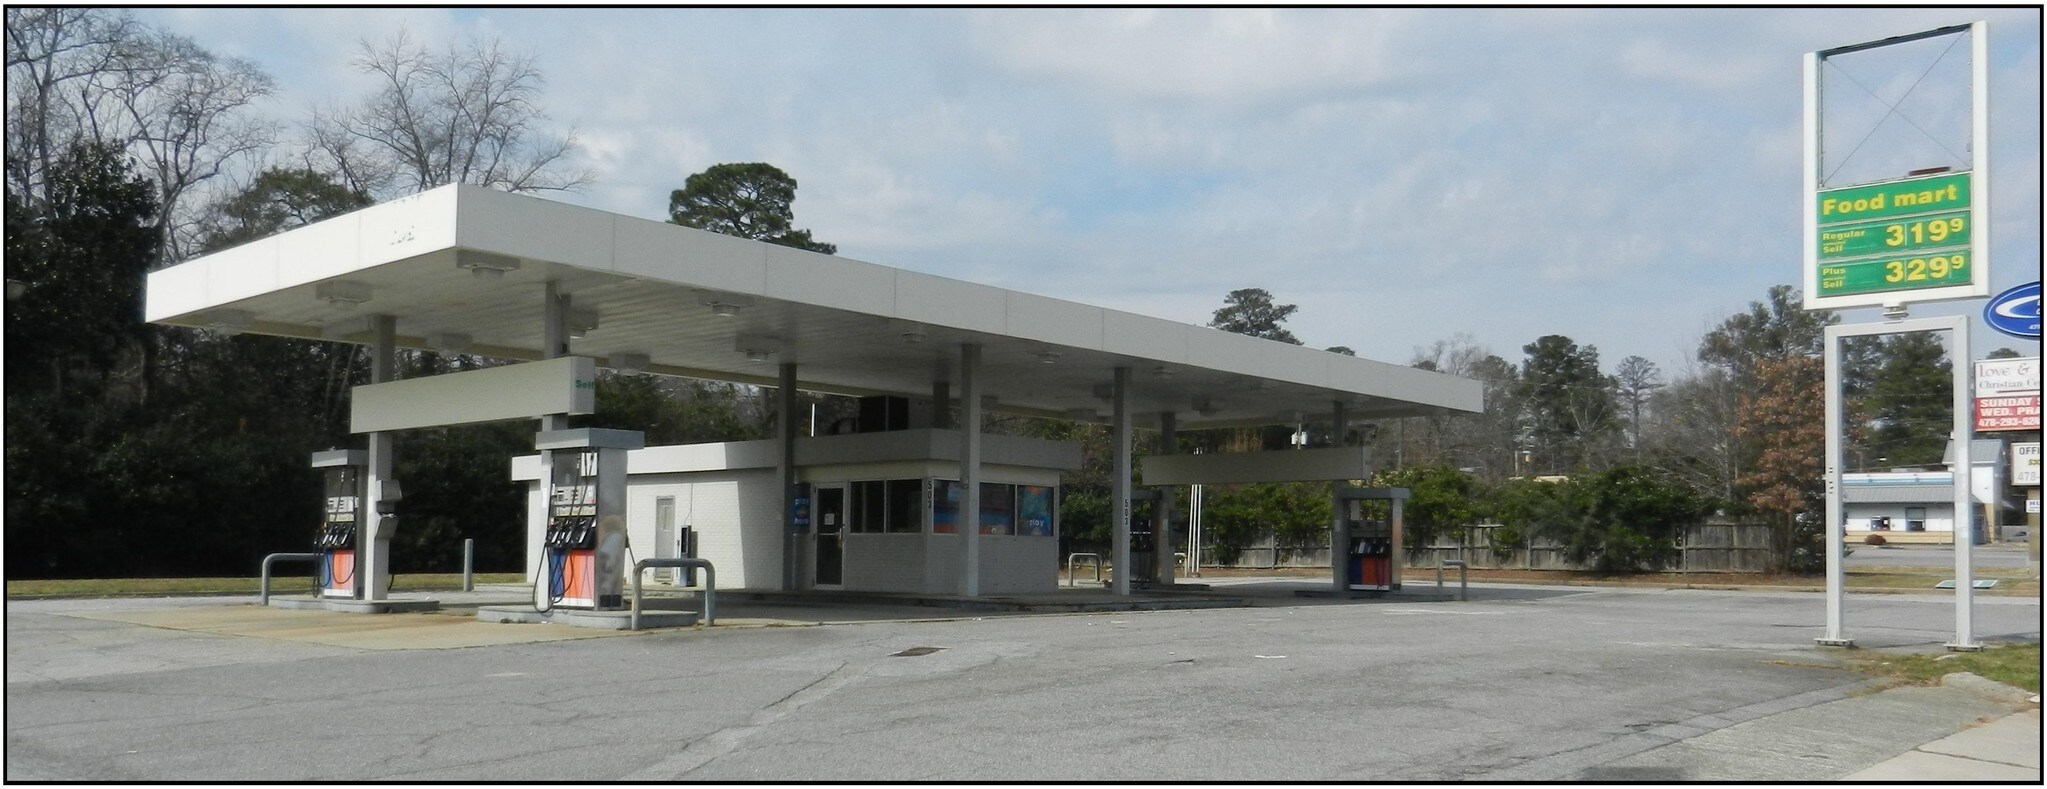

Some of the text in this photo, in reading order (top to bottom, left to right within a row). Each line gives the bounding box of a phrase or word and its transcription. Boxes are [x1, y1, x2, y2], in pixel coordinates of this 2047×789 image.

[1823, 184, 1957, 215] Food mart
[1822, 230, 1866, 240] Regular
[1822, 244, 1843, 253] Self
[1822, 267, 1846, 275] Plus
[1822, 281, 1843, 289] Self
[1979, 364, 2010, 377] Love
[1979, 380, 2023, 389] Christian
[1980, 397, 2033, 408] SUNDAY
[1980, 407, 2014, 417] WED.
